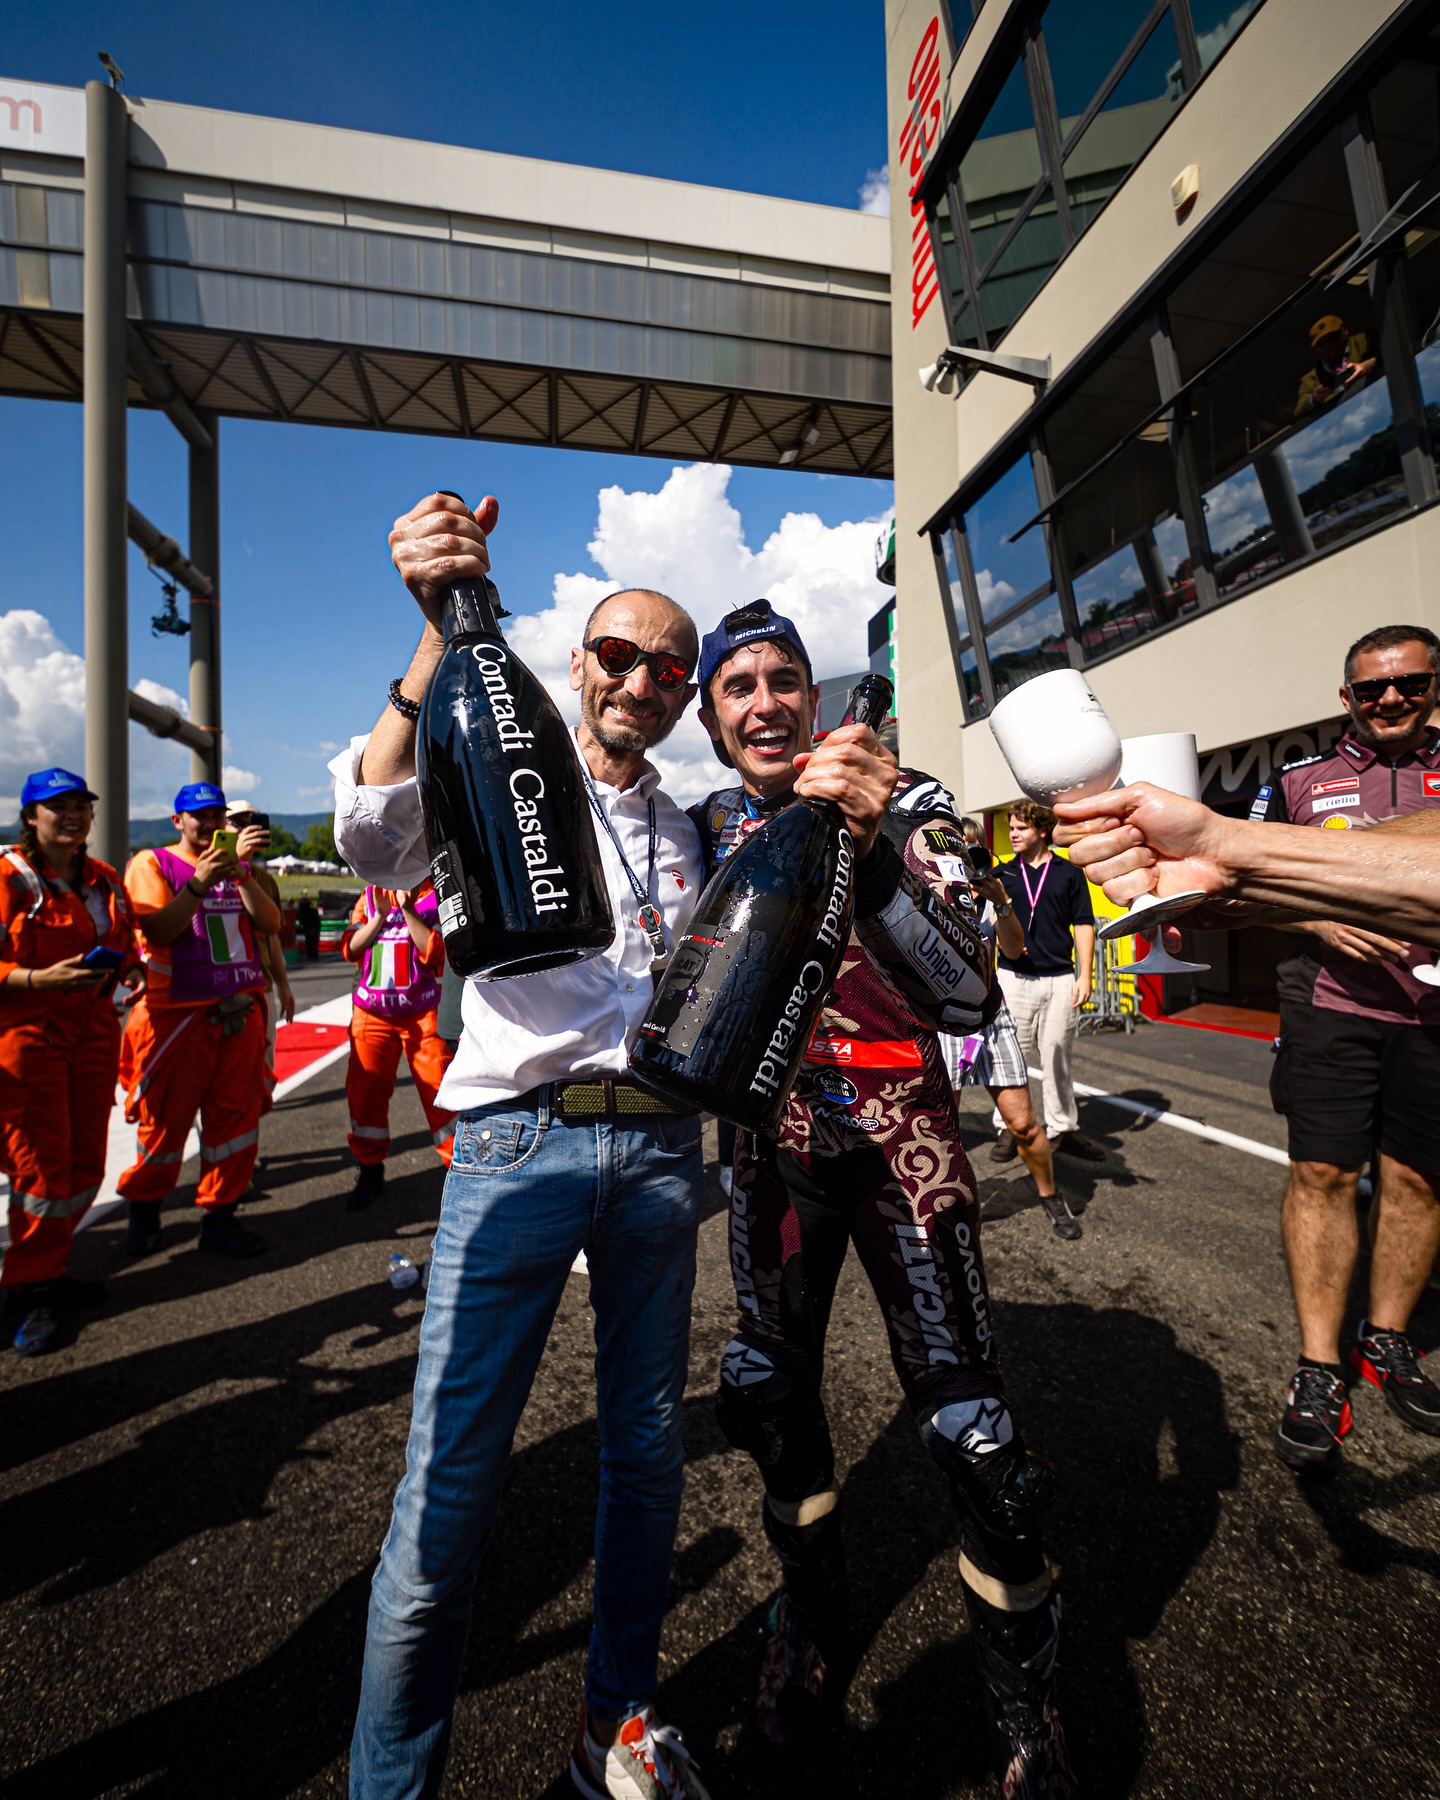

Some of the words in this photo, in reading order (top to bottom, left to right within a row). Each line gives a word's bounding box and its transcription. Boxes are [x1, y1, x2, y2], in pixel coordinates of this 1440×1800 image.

[735, 625, 776, 641] MICHELIN
[472, 642, 535, 753] Contadi
[508, 767, 570, 915] Castaldi
[1326, 796, 1356, 807] riello
[816, 827, 855, 952] Contadi
[927, 899, 975, 956] Lenovo
[918, 928, 967, 990] Unipol
[381, 993, 412, 1007] ITA
[749, 959, 825, 1102] Castaldi
[808, 1041, 852, 1055] SSA
[814, 1106, 880, 1131] MotoGP
[731, 1186, 763, 1321] DUCAT
[895, 1223, 959, 1366] DUCATI
